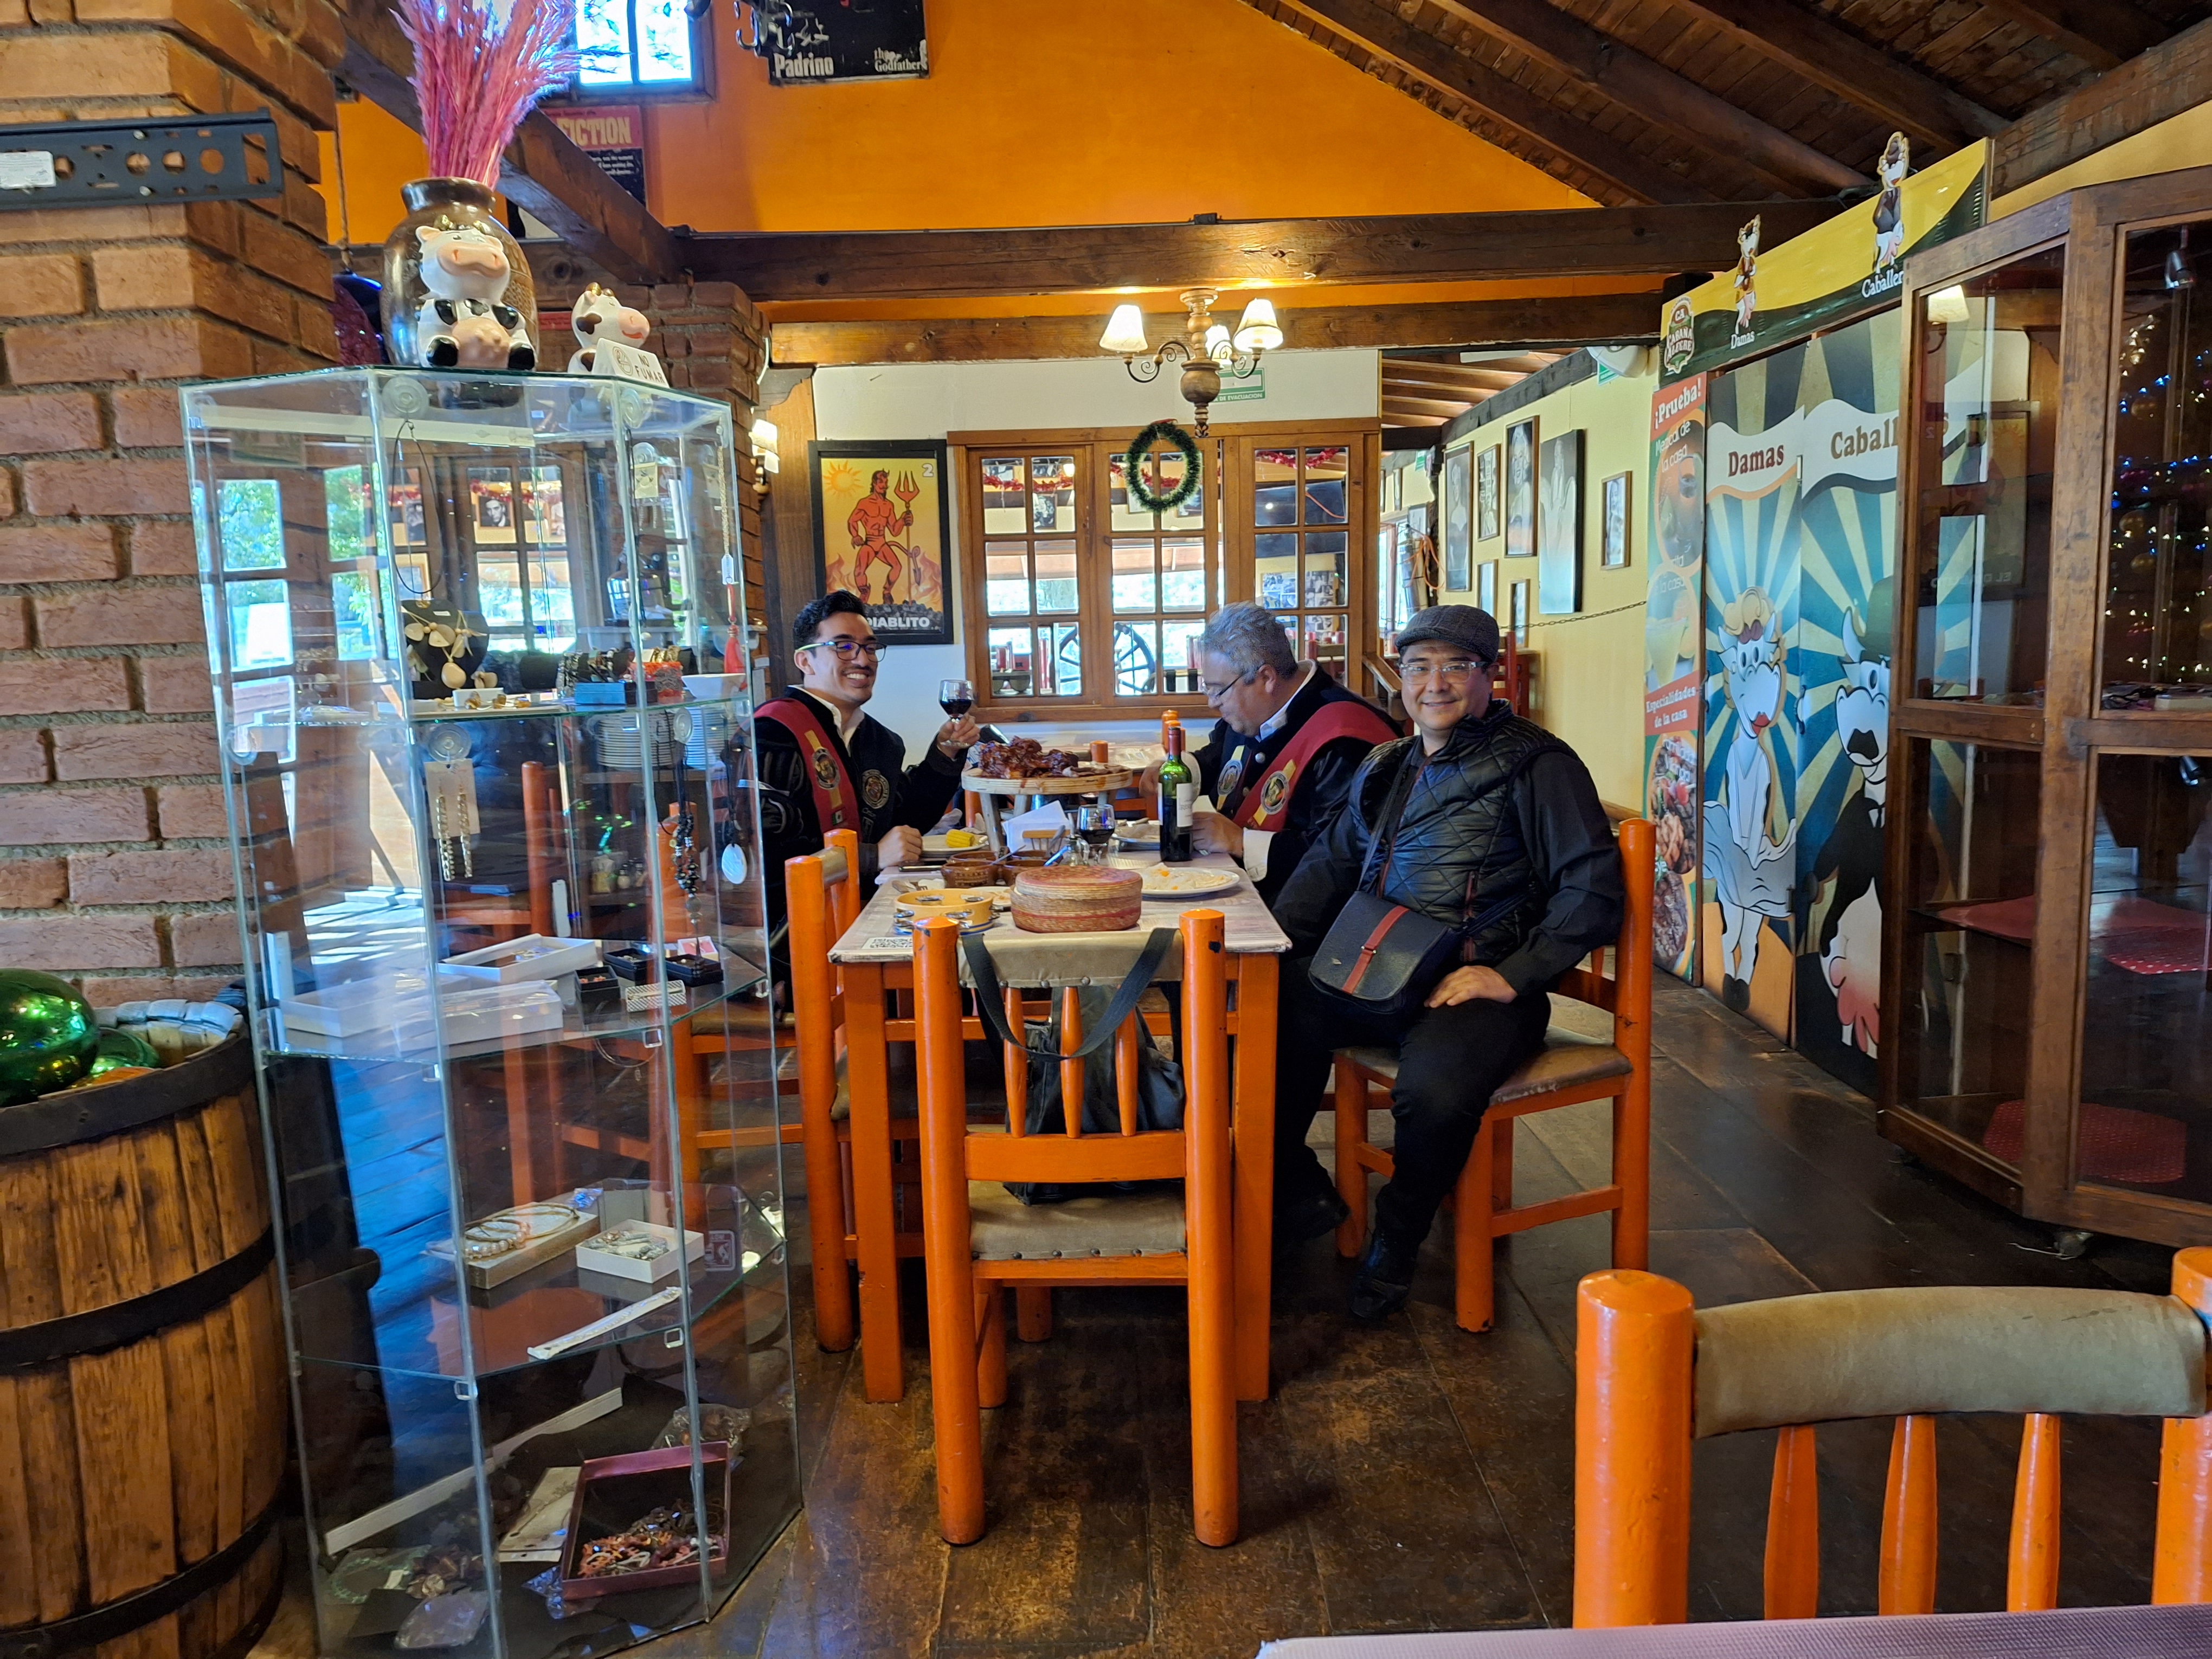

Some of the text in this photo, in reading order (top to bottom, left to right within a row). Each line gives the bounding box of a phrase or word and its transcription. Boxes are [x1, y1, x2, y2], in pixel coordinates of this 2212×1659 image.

[774, 52, 834, 78] Padrino
[874, 58, 921, 72] Godfather
[556, 117, 632, 146] FICTION
[1861, 268, 1905, 298] Caballer
[1730, 330, 1756, 350] Damas
[638, 353, 650, 367] NO
[634, 365, 665, 383] FUMAR
[1655, 377, 1701, 429] ¡Prueba!
[1655, 419, 1692, 456] Mezcal de
[1830, 416, 1899, 459] Caball
[922, 463, 934, 477] 2
[1661, 444, 1689, 473] la casa
[1728, 445, 1784, 478] Damas
[866, 616, 930, 628] DIABLITO
[1646, 686, 1696, 713] Especialidades
[1655, 709, 1688, 728] de la casa
